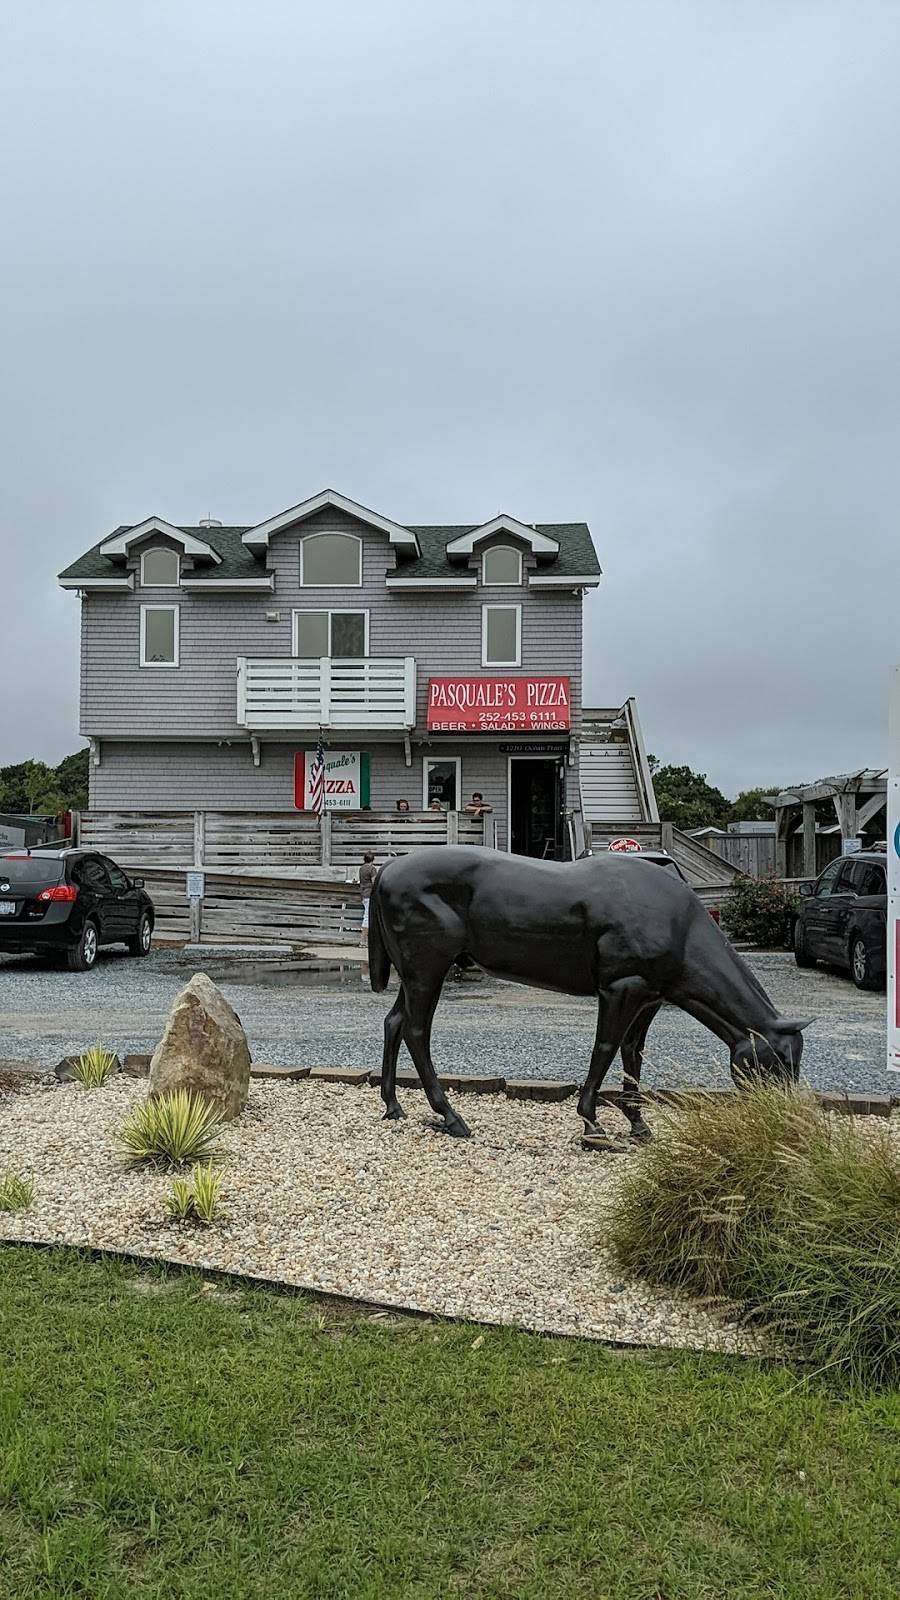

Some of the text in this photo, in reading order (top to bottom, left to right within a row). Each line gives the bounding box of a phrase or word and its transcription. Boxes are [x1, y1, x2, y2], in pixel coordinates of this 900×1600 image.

[430, 683, 568, 712] PASQUALE'S PIZZA
[478, 711, 556, 721] 252-453 6111
[432, 720, 566, 730] BEER SALAD WINGS
